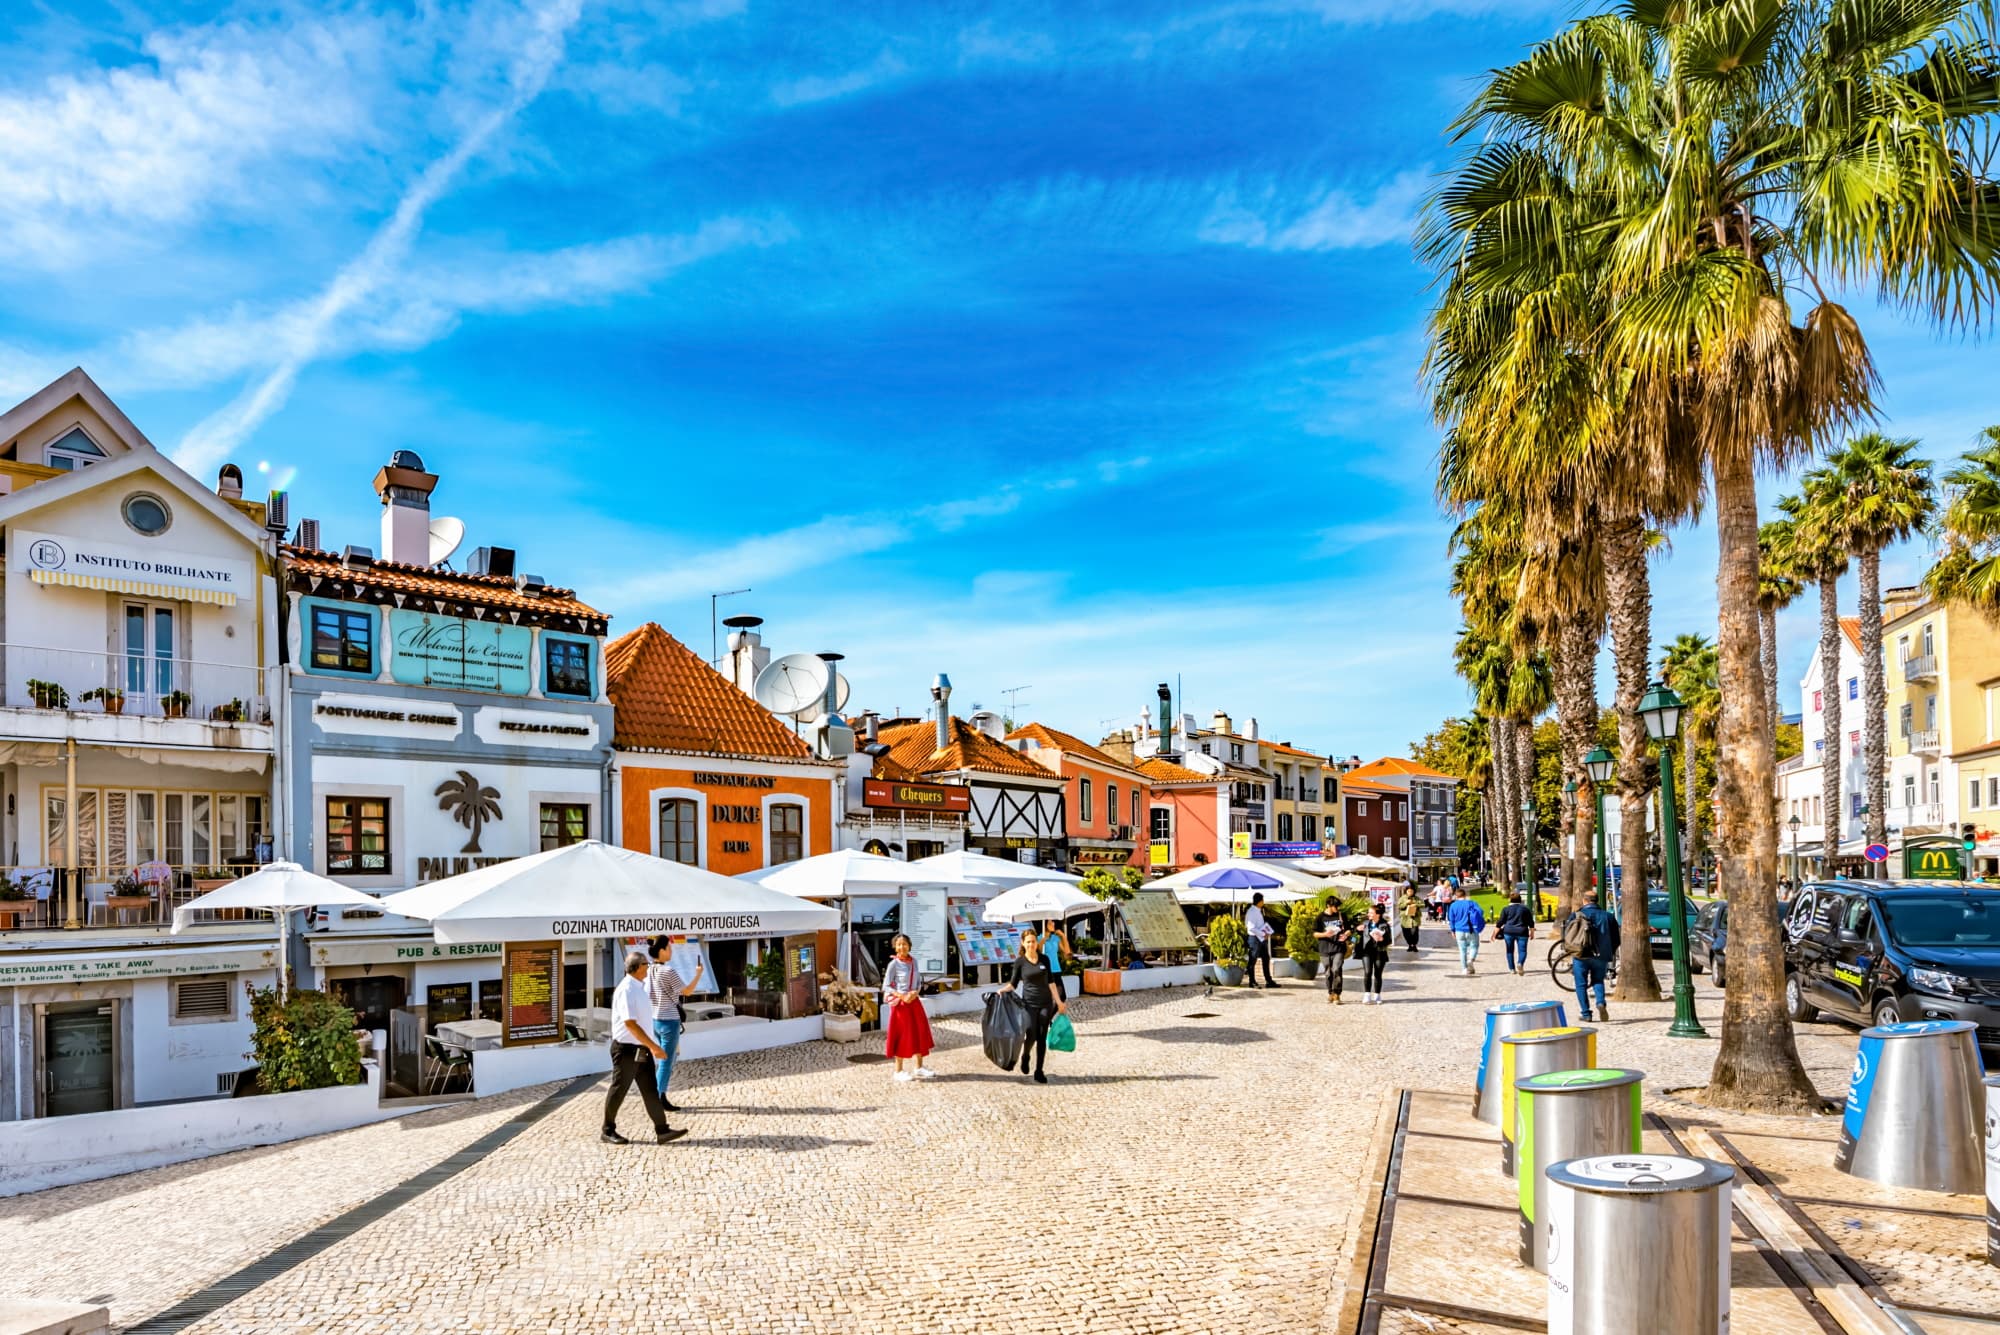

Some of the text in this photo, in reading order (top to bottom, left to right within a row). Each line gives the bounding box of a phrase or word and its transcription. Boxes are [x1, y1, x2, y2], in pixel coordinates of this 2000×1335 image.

[75, 553, 233, 583] INSTITUTO BRILHANTE
[467, 643, 480, 654] to
[482, 643, 524, 660] Cascais
[442, 656, 484, 666] BIENVNIDOS
[317, 705, 457, 726] PORTUGUESE CUISINE
[499, 721, 540, 733] PIZZAS
[550, 724, 590, 736] PASTAS
[694, 772, 777, 788] RESTAURANT
[900, 786, 942, 804] Chequers
[713, 804, 760, 824] DUKE
[723, 840, 751, 853] PUB
[418, 857, 469, 880] PALM
[553, 915, 760, 935] COZINHA TRADICIONAL PORTUGUESA
[397, 947, 424, 957] PUB
[432, 946, 441, 956] &
[0, 964, 75, 975] RESTAURANTE
[95, 961, 121, 970] TAKE
[127, 959, 154, 967] AWAY
[73, 970, 110, 979] Speciality
[175, 965, 187, 973] Pig
[223, 962, 240, 970] Style
